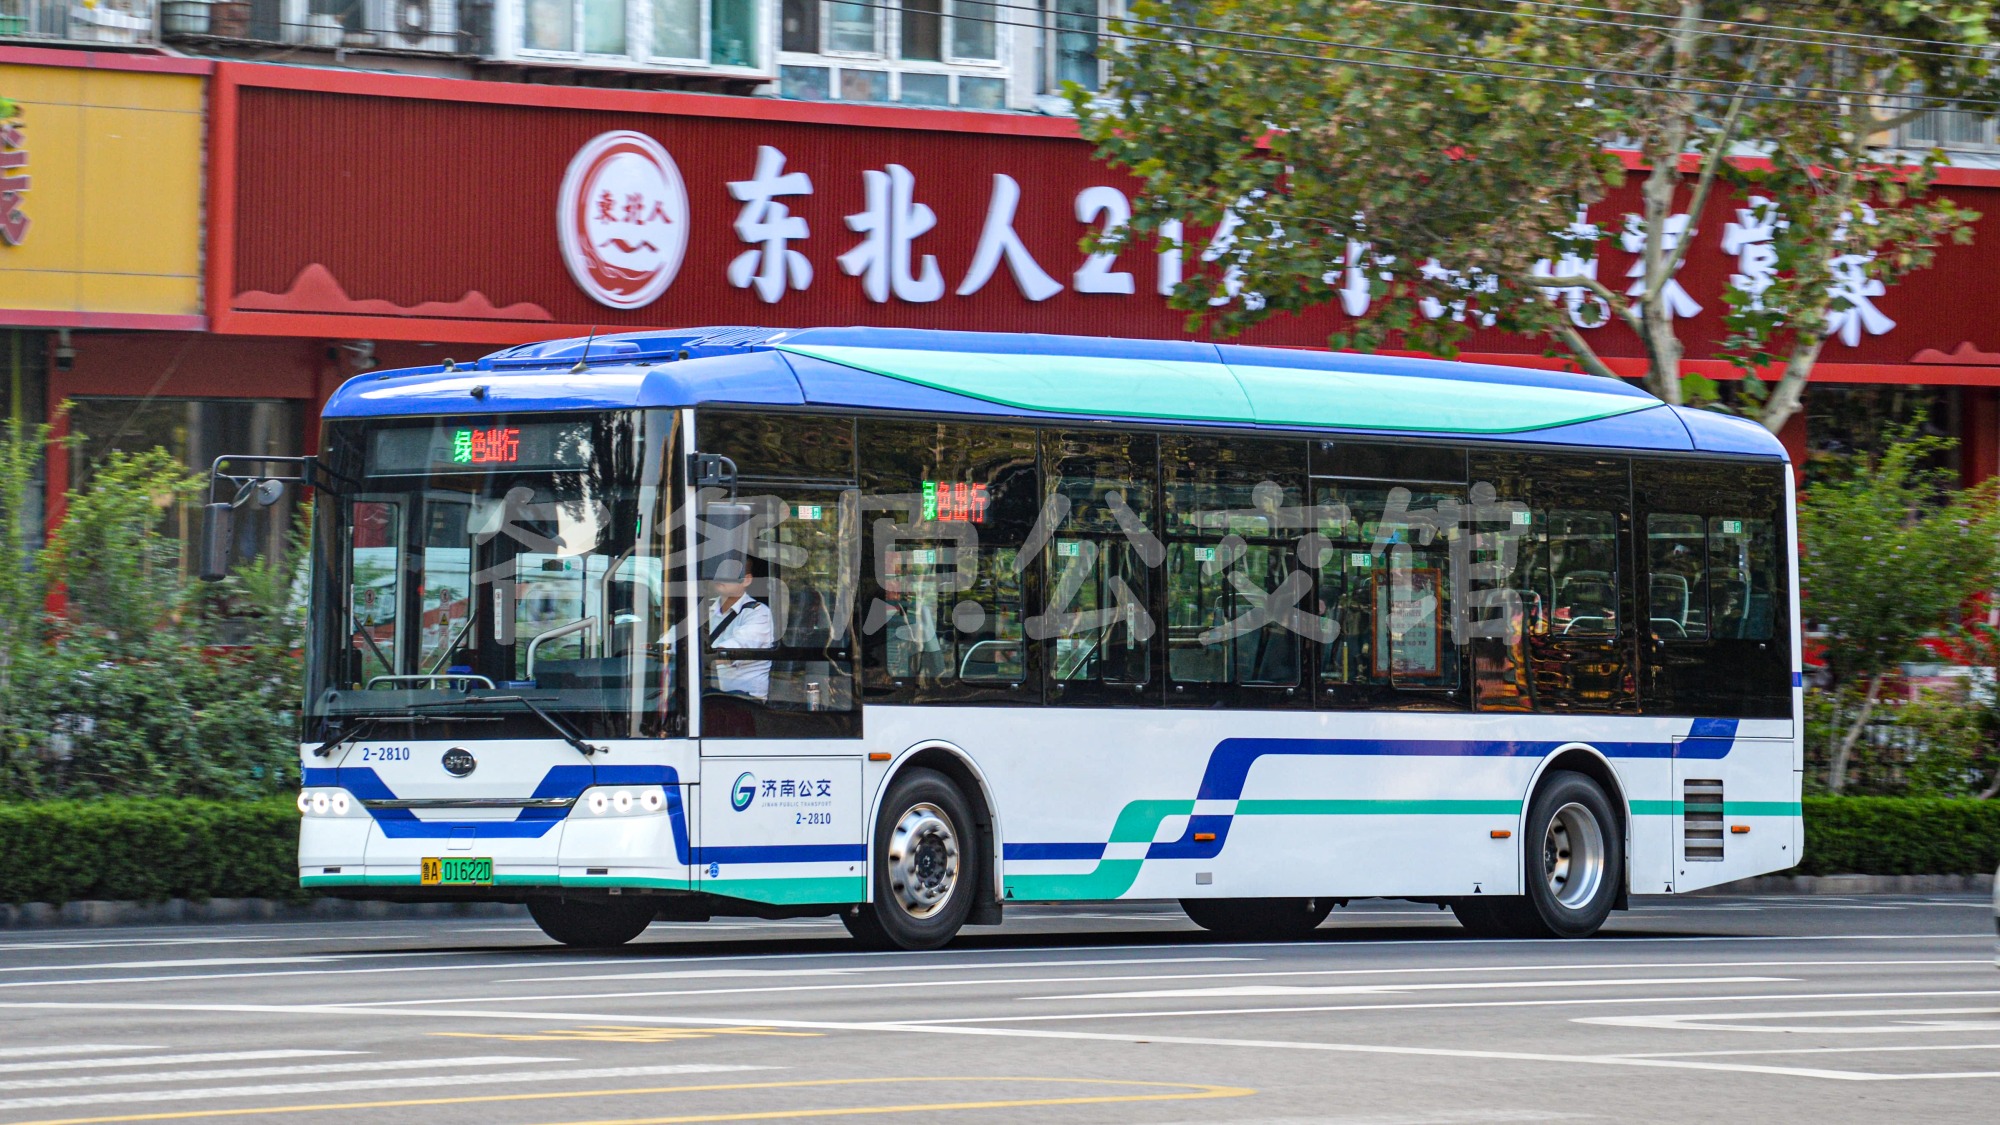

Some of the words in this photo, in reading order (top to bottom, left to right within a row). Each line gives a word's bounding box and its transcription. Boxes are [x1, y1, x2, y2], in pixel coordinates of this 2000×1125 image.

[453, 428, 519, 463] 绿色出行
[922, 480, 987, 523] 绿色出行
[362, 747, 410, 761] 2-2810
[761, 779, 831, 797] 济南公交
[795, 812, 831, 825] 2-2810
